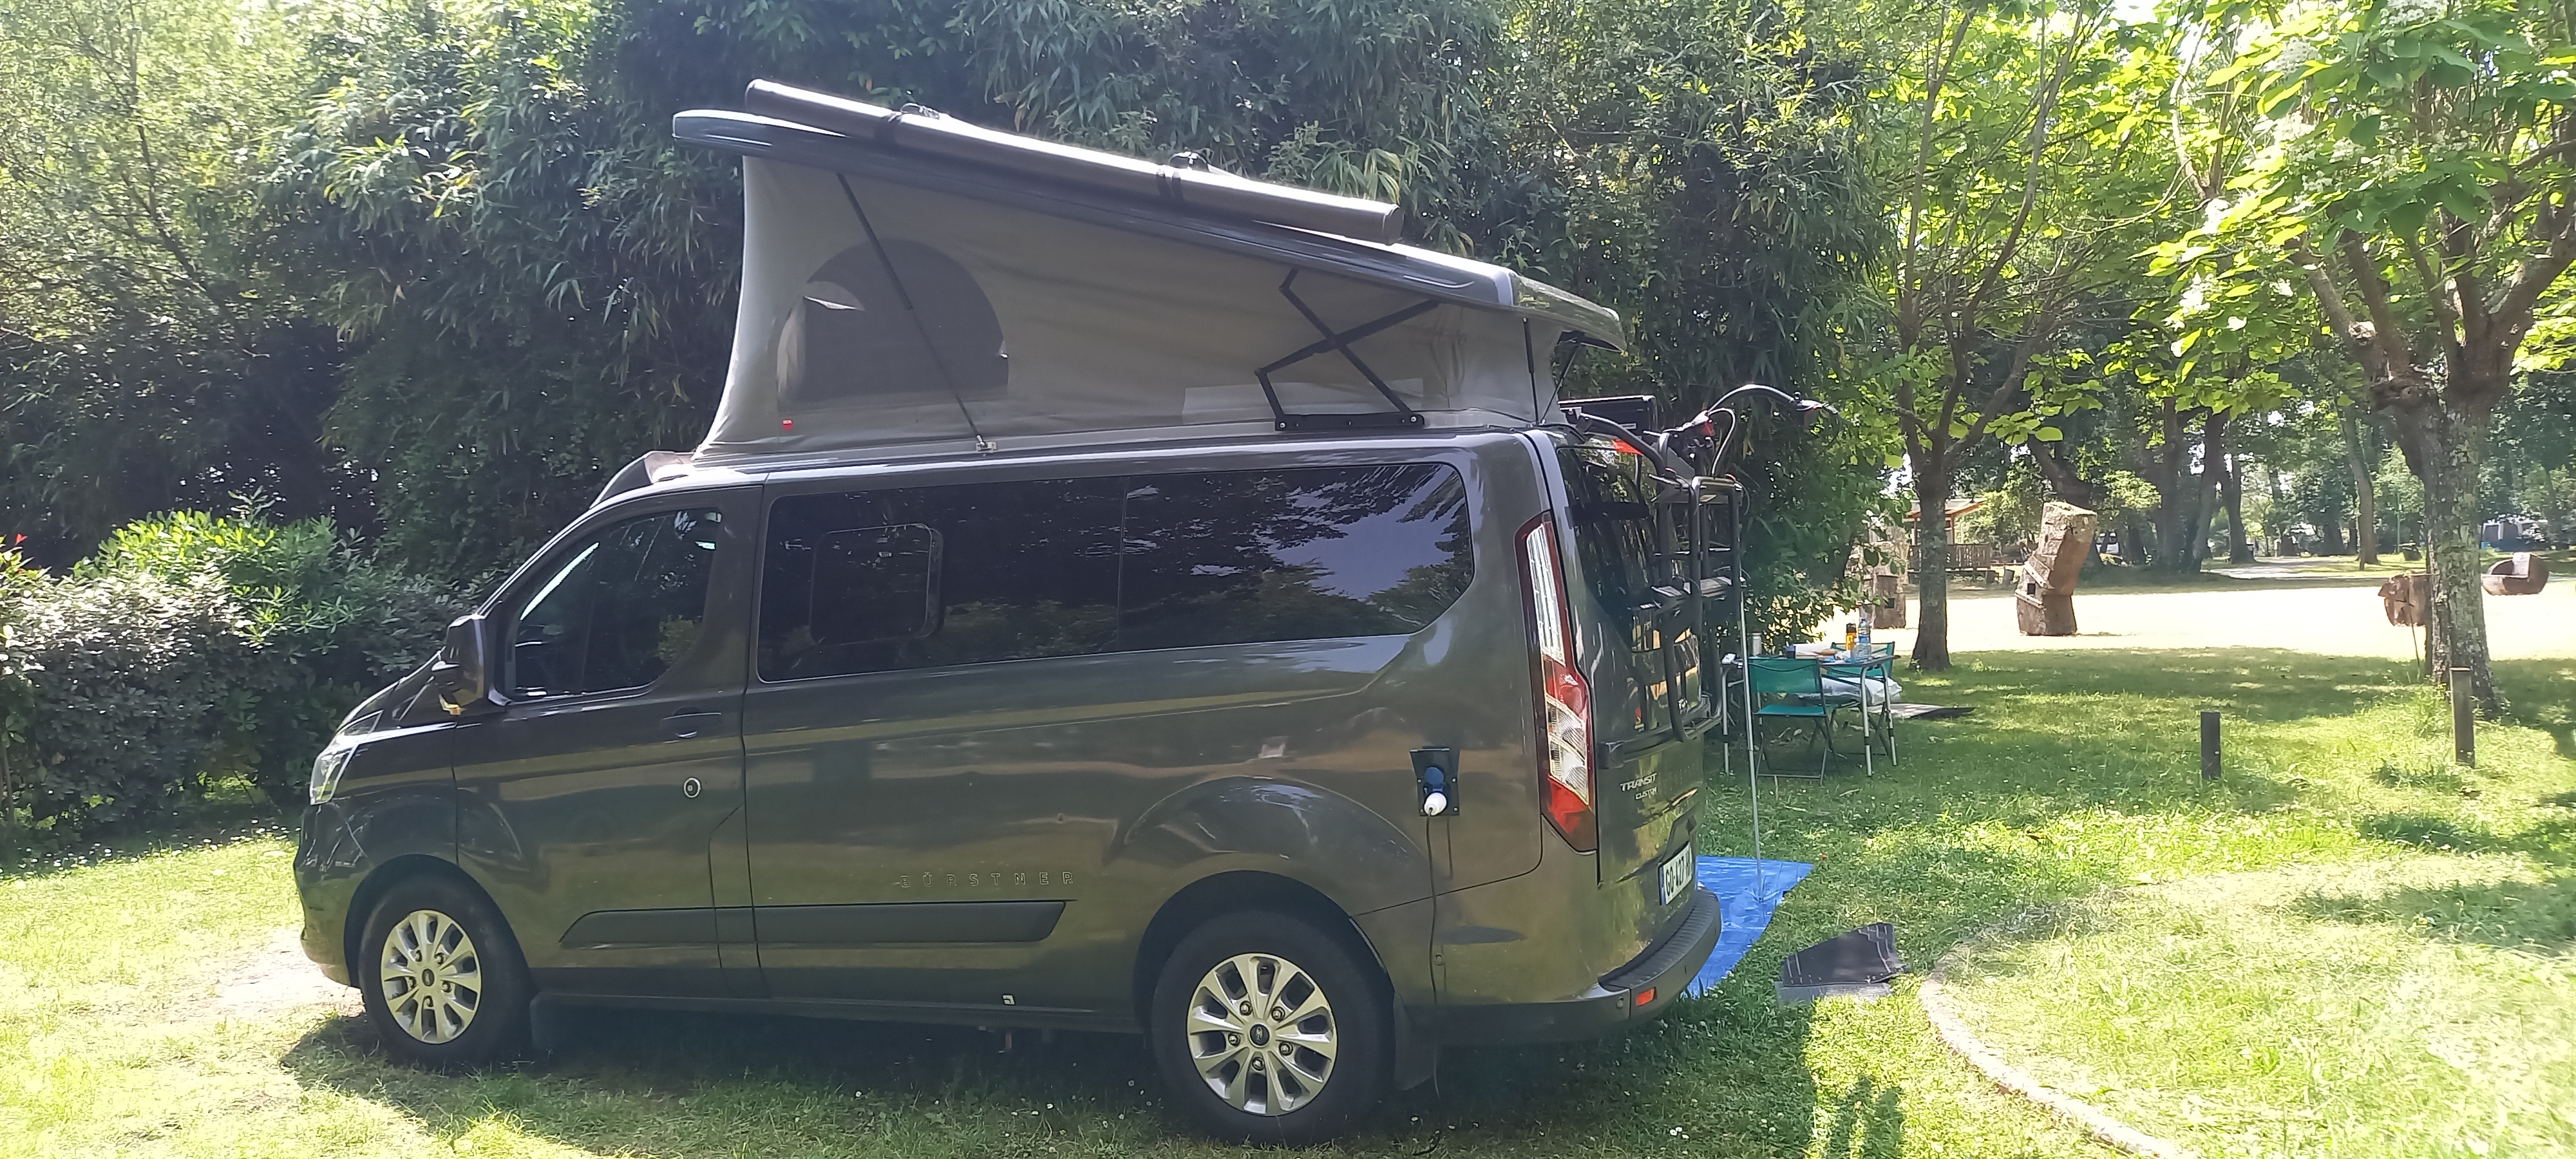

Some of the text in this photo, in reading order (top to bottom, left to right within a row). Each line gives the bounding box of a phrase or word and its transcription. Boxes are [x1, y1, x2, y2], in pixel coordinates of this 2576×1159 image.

[1620, 773, 1657, 791] TRANSIT
[1635, 786, 1658, 800] CUSTOM
[900, 871, 1074, 888] BÜRSTNER
